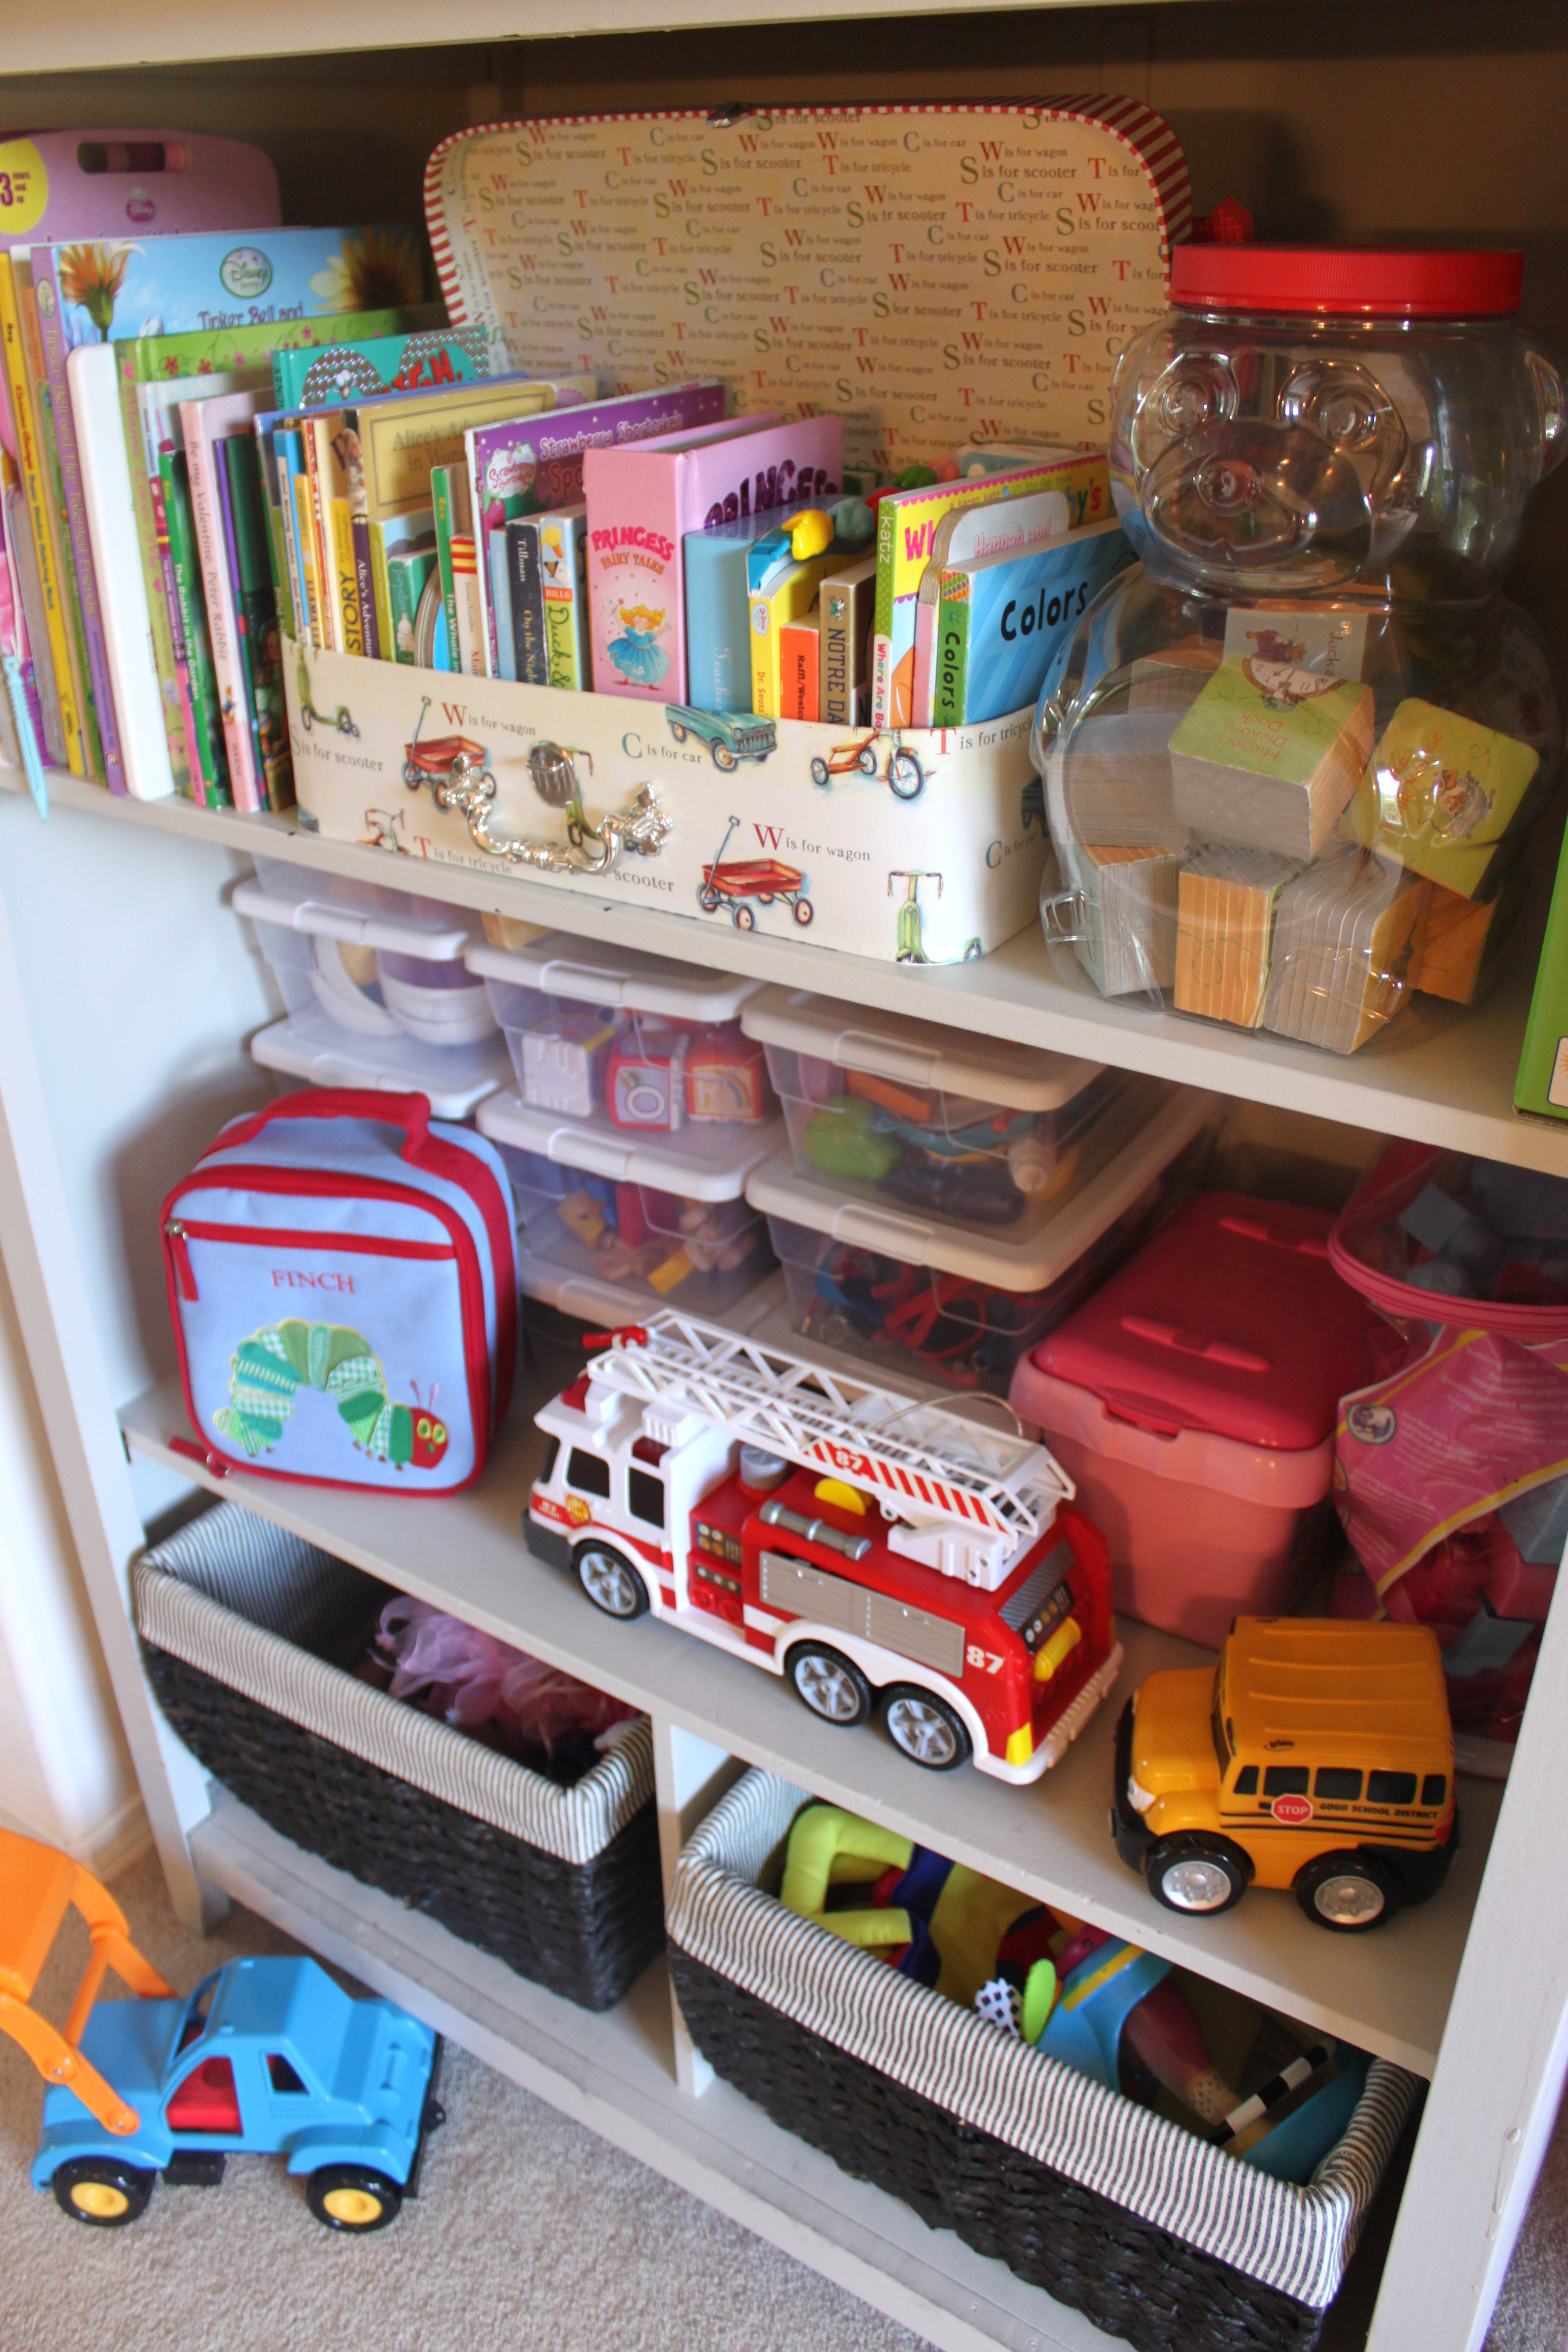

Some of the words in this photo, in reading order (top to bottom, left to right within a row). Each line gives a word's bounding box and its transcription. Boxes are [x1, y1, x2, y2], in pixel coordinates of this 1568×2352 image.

[979, 141, 1004, 161] W
[1005, 147, 1013, 157] is
[1017, 147, 1031, 157] for
[1035, 148, 1068, 159] wagon
[961, 156, 979, 185] S
[982, 165, 994, 178] is
[999, 165, 1019, 178] for
[1024, 167, 1077, 179] scooter
[1087, 158, 1106, 179] T
[1109, 166, 1119, 177] is
[1123, 165, 1140, 177] for
[998, 181, 1014, 202] C
[1018, 189, 1027, 198] is
[1029, 188, 1043, 198] for
[955, 201, 974, 223] T
[975, 209, 985, 220] is
[988, 209, 1005, 220] for
[1008, 210, 1050, 225] tricycle
[1056, 206, 1075, 236] S
[1078, 217, 1091, 230] is
[1096, 217, 1116, 230] for
[983, 249, 1001, 277] S
[1005, 259, 1017, 271] is
[1021, 259, 1041, 272] for
[1045, 261, 1098, 274] scooter
[197, 308, 244, 331] Tinker
[248, 303, 274, 327] Bell
[278, 299, 304, 322] and
[46, 329, 61, 379] Tinker
[943, 344, 960, 370] S
[964, 354, 975, 365] is
[979, 353, 998, 367] for
[1002, 356, 1052, 370] scooter
[392, 423, 440, 451] Alice's
[540, 430, 613, 462] Strawberry
[616, 410, 684, 444] Shortcake's
[489, 462, 535, 489] Strawberry
[590, 526, 675, 561] PRINCESS
[879, 516, 894, 565] katz
[517, 538, 526, 583] Tillman
[599, 552, 630, 570] FAIRY
[632, 553, 665, 575] TALES
[357, 559, 369, 598] Alice's
[544, 588, 570, 599] HILLS
[340, 570, 362, 652] STORY
[523, 610, 533, 629] On
[1000, 581, 1088, 642] Colors
[178, 586, 190, 624] Rabbit
[188, 659, 198, 700] Garden
[449, 618, 460, 658] Whale
[525, 632, 536, 650] the
[547, 604, 572, 667] Duck
[1325, 631, 1343, 669] Jack
[828, 628, 845, 693] NOTRE
[877, 643, 886, 684] Where
[942, 631, 961, 709] Colors
[757, 671, 766, 685] Dr.
[876, 687, 885, 711] Are
[440, 702, 467, 728] W
[468, 714, 478, 726] is
[481, 716, 497, 729] for
[501, 722, 536, 736] wagon
[1242, 712, 1284, 733] Dock
[290, 724, 300, 755] S
[301, 738, 311, 755] is
[313, 743, 331, 761] for
[334, 751, 384, 772] scooter
[621, 732, 642, 759] C
[646, 744, 657, 756] is
[661, 745, 678, 759] for
[682, 752, 702, 763] car
[930, 727, 957, 755] T
[959, 736, 974, 750] is
[978, 732, 997, 746] for
[413, 835, 431, 859] T
[434, 847, 444, 860] is
[447, 850, 465, 865] for
[468, 856, 512, 874] tricycle
[751, 823, 785, 851] W
[785, 837, 797, 850] is
[802, 839, 821, 854] for
[826, 846, 871, 862] wagon
[985, 840, 1002, 869] C
[613, 869, 674, 891] scooter
[269, 1269, 355, 1295] FINCH
[835, 1450, 863, 1472] 87
[966, 1644, 1004, 1675] 87
[1277, 1804, 1309, 1815] STOP
[1320, 1803, 1349, 1812] GOGO
[1352, 1805, 1390, 1815] SCHOOL
[1394, 1808, 1439, 1820] DISTRICT
